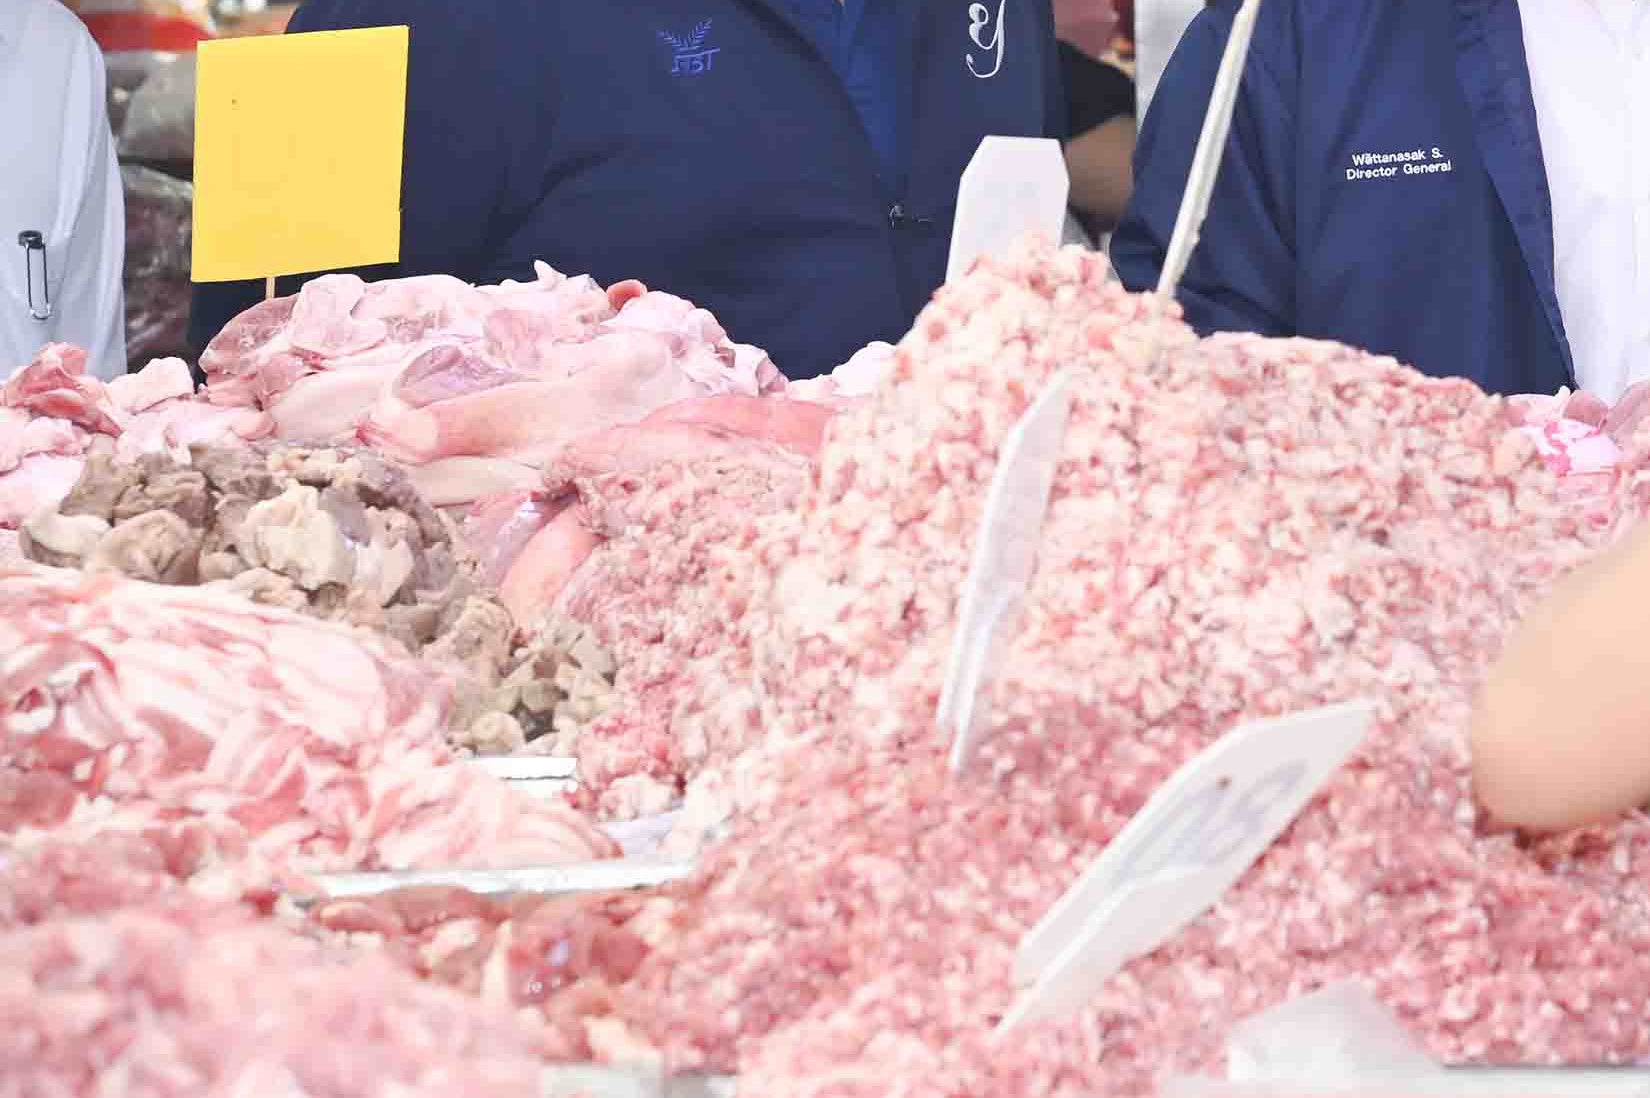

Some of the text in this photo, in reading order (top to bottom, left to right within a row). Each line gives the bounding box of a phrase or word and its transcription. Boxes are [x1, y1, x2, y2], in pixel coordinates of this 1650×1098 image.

[1431, 147, 1444, 159] S.
[1346, 160, 1452, 180] Director General
